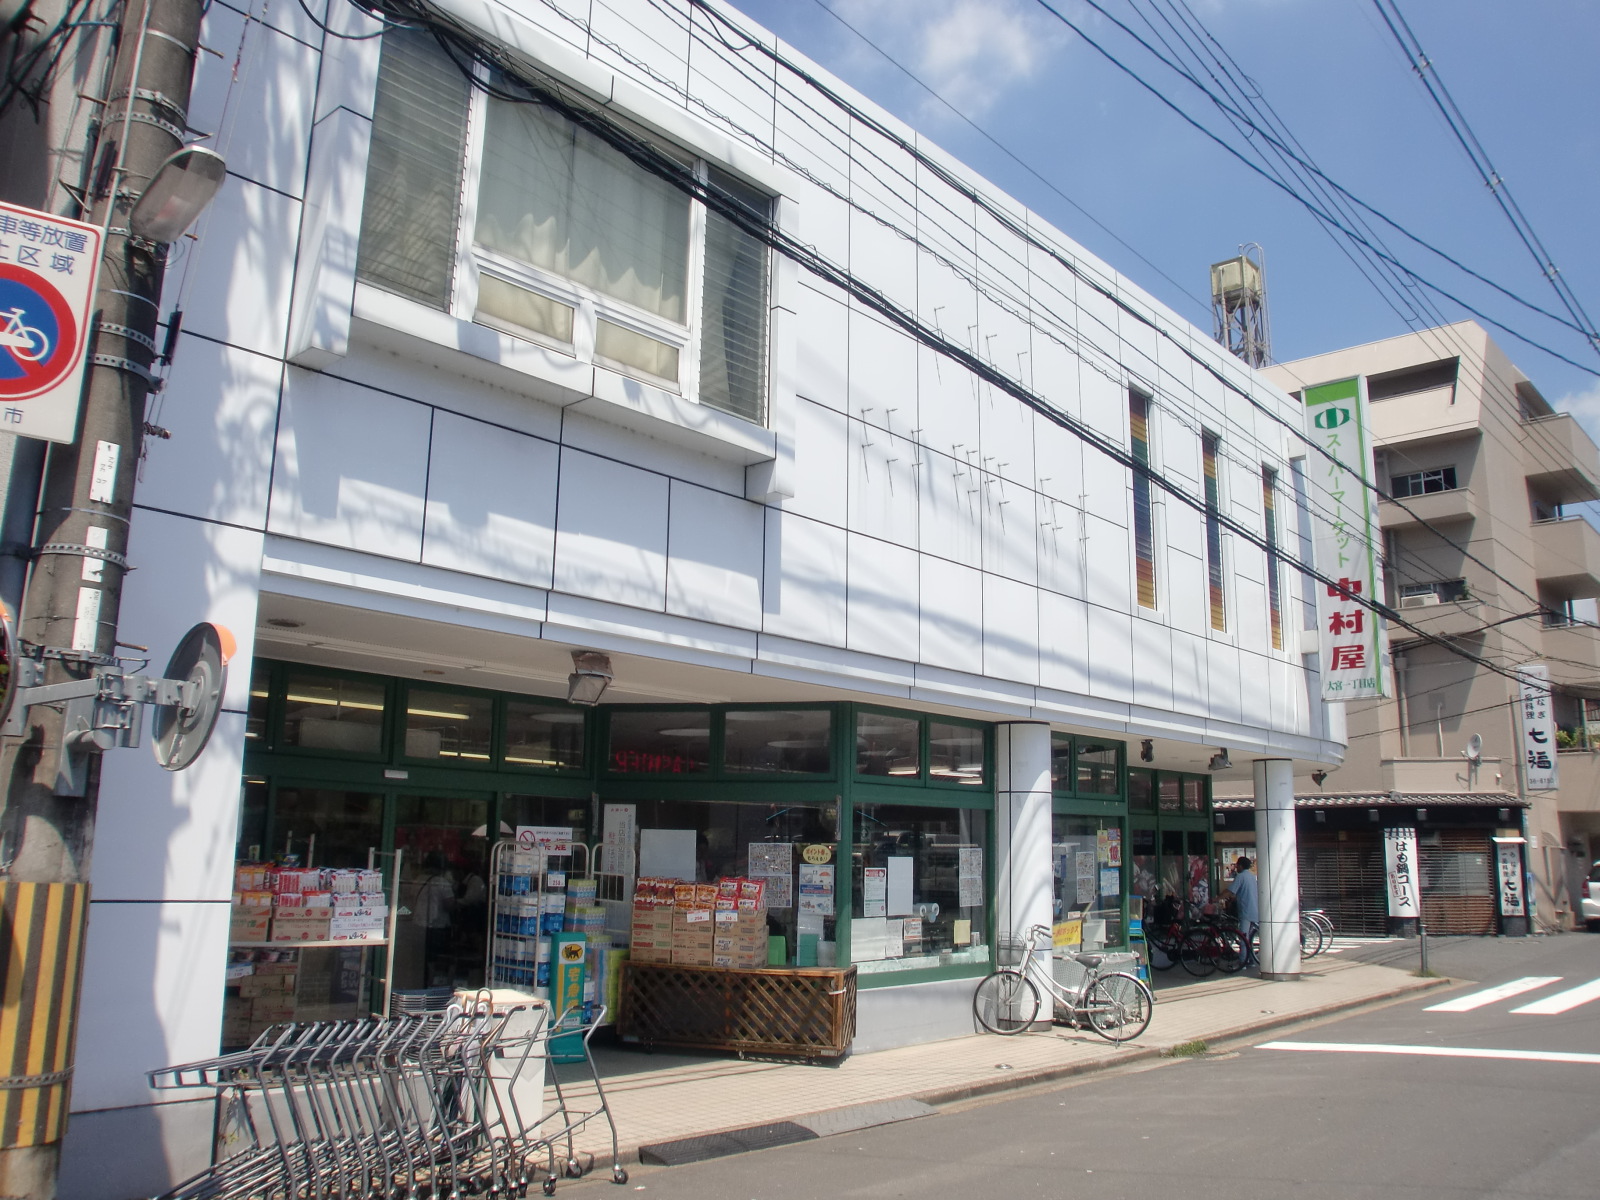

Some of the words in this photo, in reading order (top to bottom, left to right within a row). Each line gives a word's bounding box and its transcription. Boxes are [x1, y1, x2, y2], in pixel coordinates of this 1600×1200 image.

[4, 407, 24, 425] 市
[1326, 577, 1367, 671] 中村屋
[1528, 727, 1552, 770] 七福
[1395, 841, 1411, 907] はも鍋コース
[1504, 879, 1519, 906] 七福
